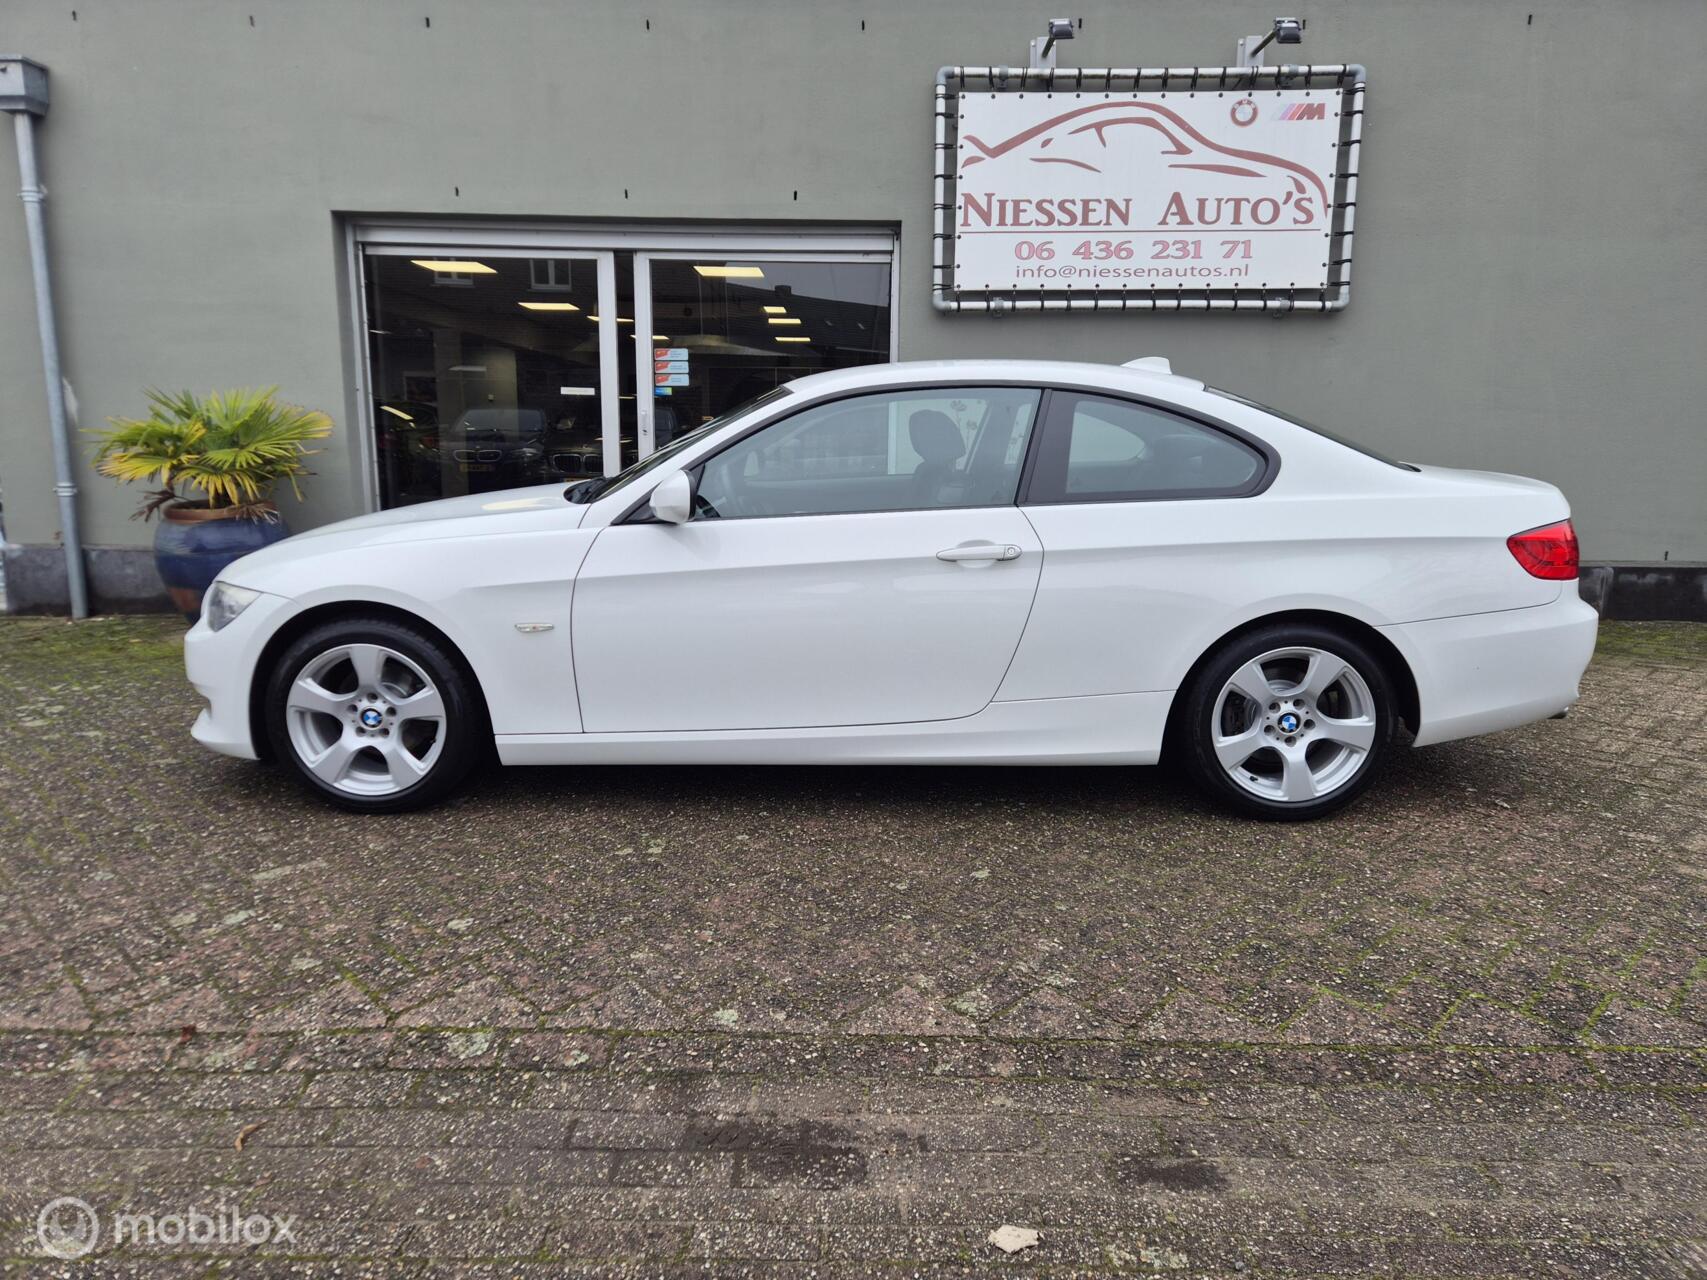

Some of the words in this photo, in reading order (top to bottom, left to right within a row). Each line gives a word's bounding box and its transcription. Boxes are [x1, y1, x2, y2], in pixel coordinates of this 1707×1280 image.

[960, 192, 1133, 227] NIESSEN
[1014, 240, 1056, 260] 06
[1072, 240, 1135, 260] 436
[1150, 239, 1203, 259] 231
[1220, 239, 1253, 259] 71
[1016, 263, 1250, 279] info@niessenautos.nl
